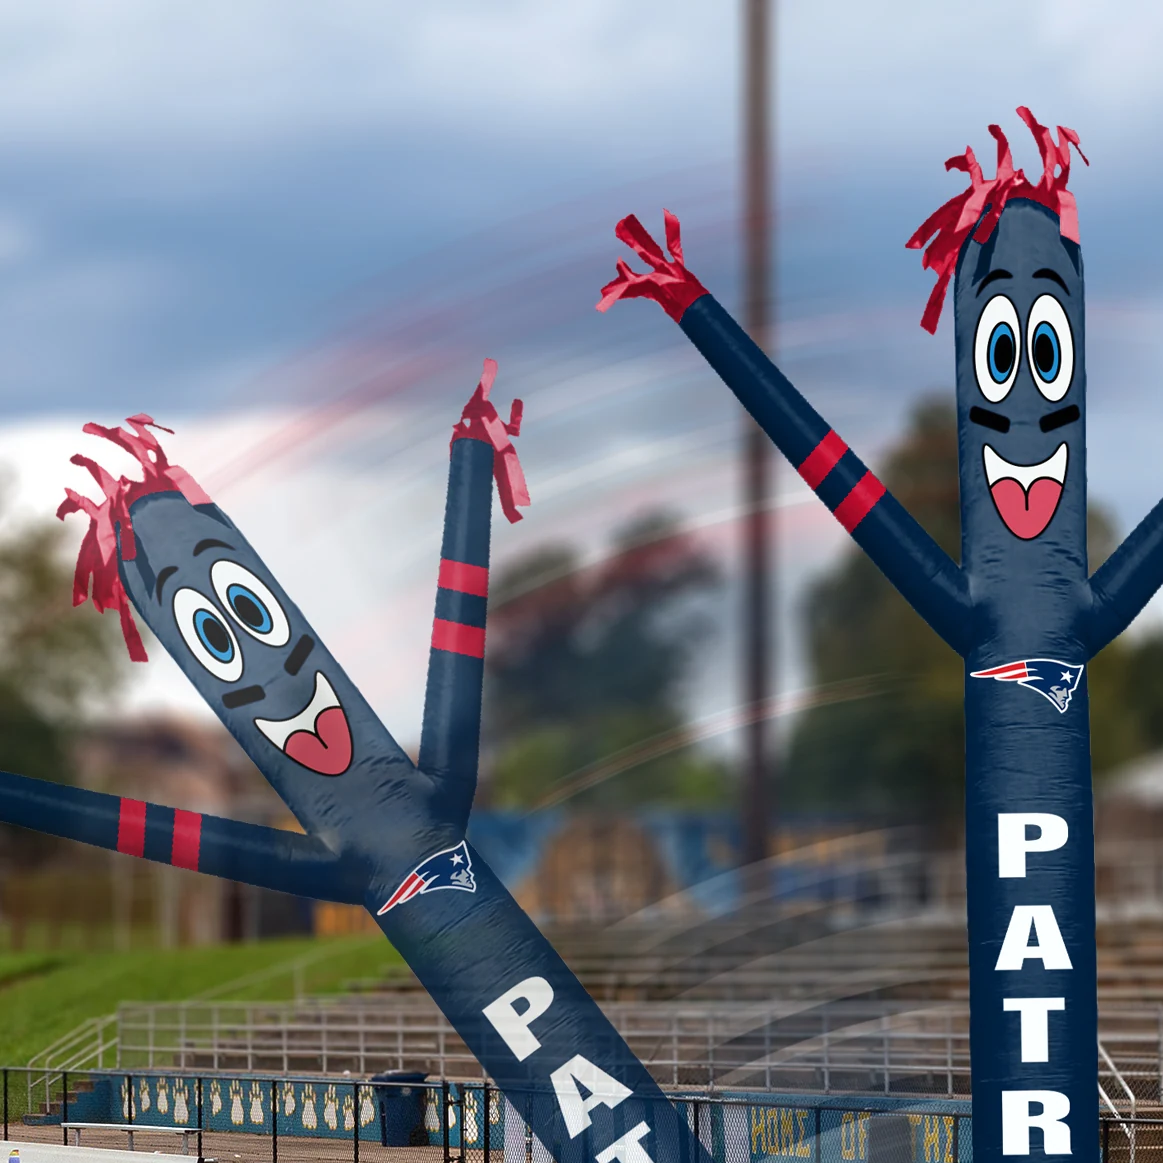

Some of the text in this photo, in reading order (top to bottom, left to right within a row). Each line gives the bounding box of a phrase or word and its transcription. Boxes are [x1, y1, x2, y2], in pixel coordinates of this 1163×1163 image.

[751, 1107, 954, 1163] HOME OF THE
